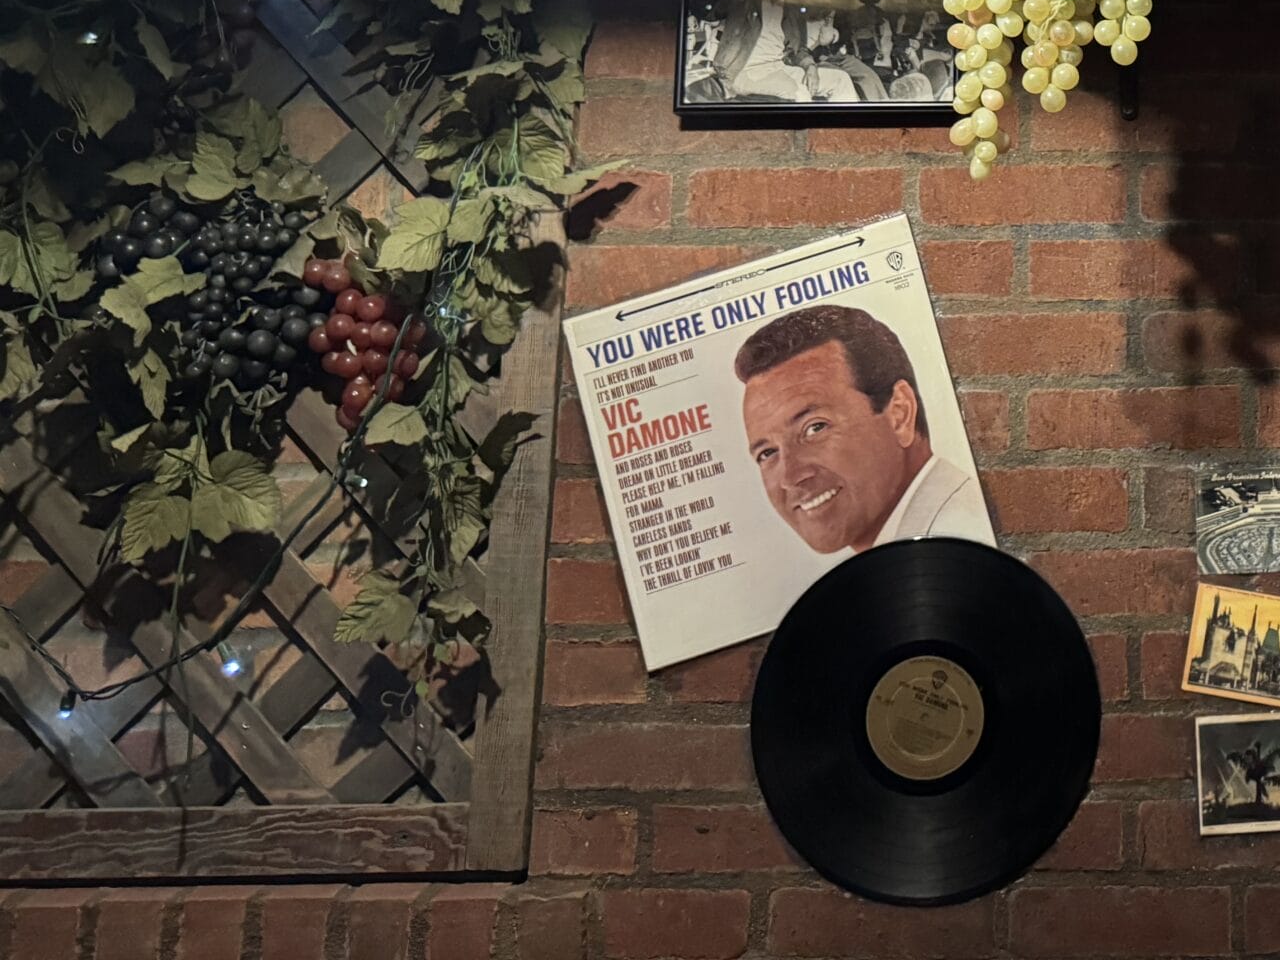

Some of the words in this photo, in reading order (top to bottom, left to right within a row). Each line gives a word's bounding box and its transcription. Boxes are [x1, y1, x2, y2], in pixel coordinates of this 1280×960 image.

[714, 268, 767, 288] STEREO
[587, 334, 635, 368] YOU
[639, 313, 705, 349] WERE
[711, 291, 767, 330] ONLY
[774, 260, 870, 309] FOOLING
[593, 377, 606, 390] I'LL
[607, 370, 630, 385] NEVER
[630, 365, 647, 378] FIND
[648, 354, 678, 373] ANOTHER
[679, 349, 694, 362] YOU
[597, 391, 610, 404] IT'S
[611, 386, 625, 399] NOT
[626, 375, 658, 394] UNUSUAL
[601, 398, 642, 431] VIC
[608, 404, 712, 459] DAMONE
[615, 463, 630, 475] AND
[630, 454, 653, 469] ROSES
[655, 449, 669, 461] AND
[671, 441, 693, 457] ROSES
[618, 474, 642, 490] DREAM
[645, 469, 655, 481] ON
[656, 462, 678, 478] LITTLE
[679, 450, 713, 469] DREAMER
[622, 486, 648, 504] PLEASE
[648, 481, 666, 496] HELP
[682, 472, 695, 485] I'M
[696, 462, 725, 481] FALLING
[625, 506, 639, 518] FOR
[641, 497, 664, 514] MAMA
[629, 512, 664, 533] STRANGER
[666, 510, 673, 521] IN
[675, 505, 689, 518] THE
[690, 496, 715, 514] WORLD
[632, 527, 668, 548] CARELESS
[669, 520, 693, 536] HANDS
[636, 548, 652, 562] WHY
[654, 541, 674, 556] DON'T
[675, 537, 690, 550] YOU
[691, 525, 719, 545] BELIEVE
[719, 522, 733, 536] ME
[640, 563, 654, 576] I'VE
[655, 556, 674, 570] BEEN
[674, 547, 701, 565] LOOKIN'
[643, 577, 658, 591] THE
[658, 570, 682, 587] THRILL
[683, 566, 693, 580] OF
[694, 558, 715, 576] LOVIN'
[717, 554, 733, 566] YOU
